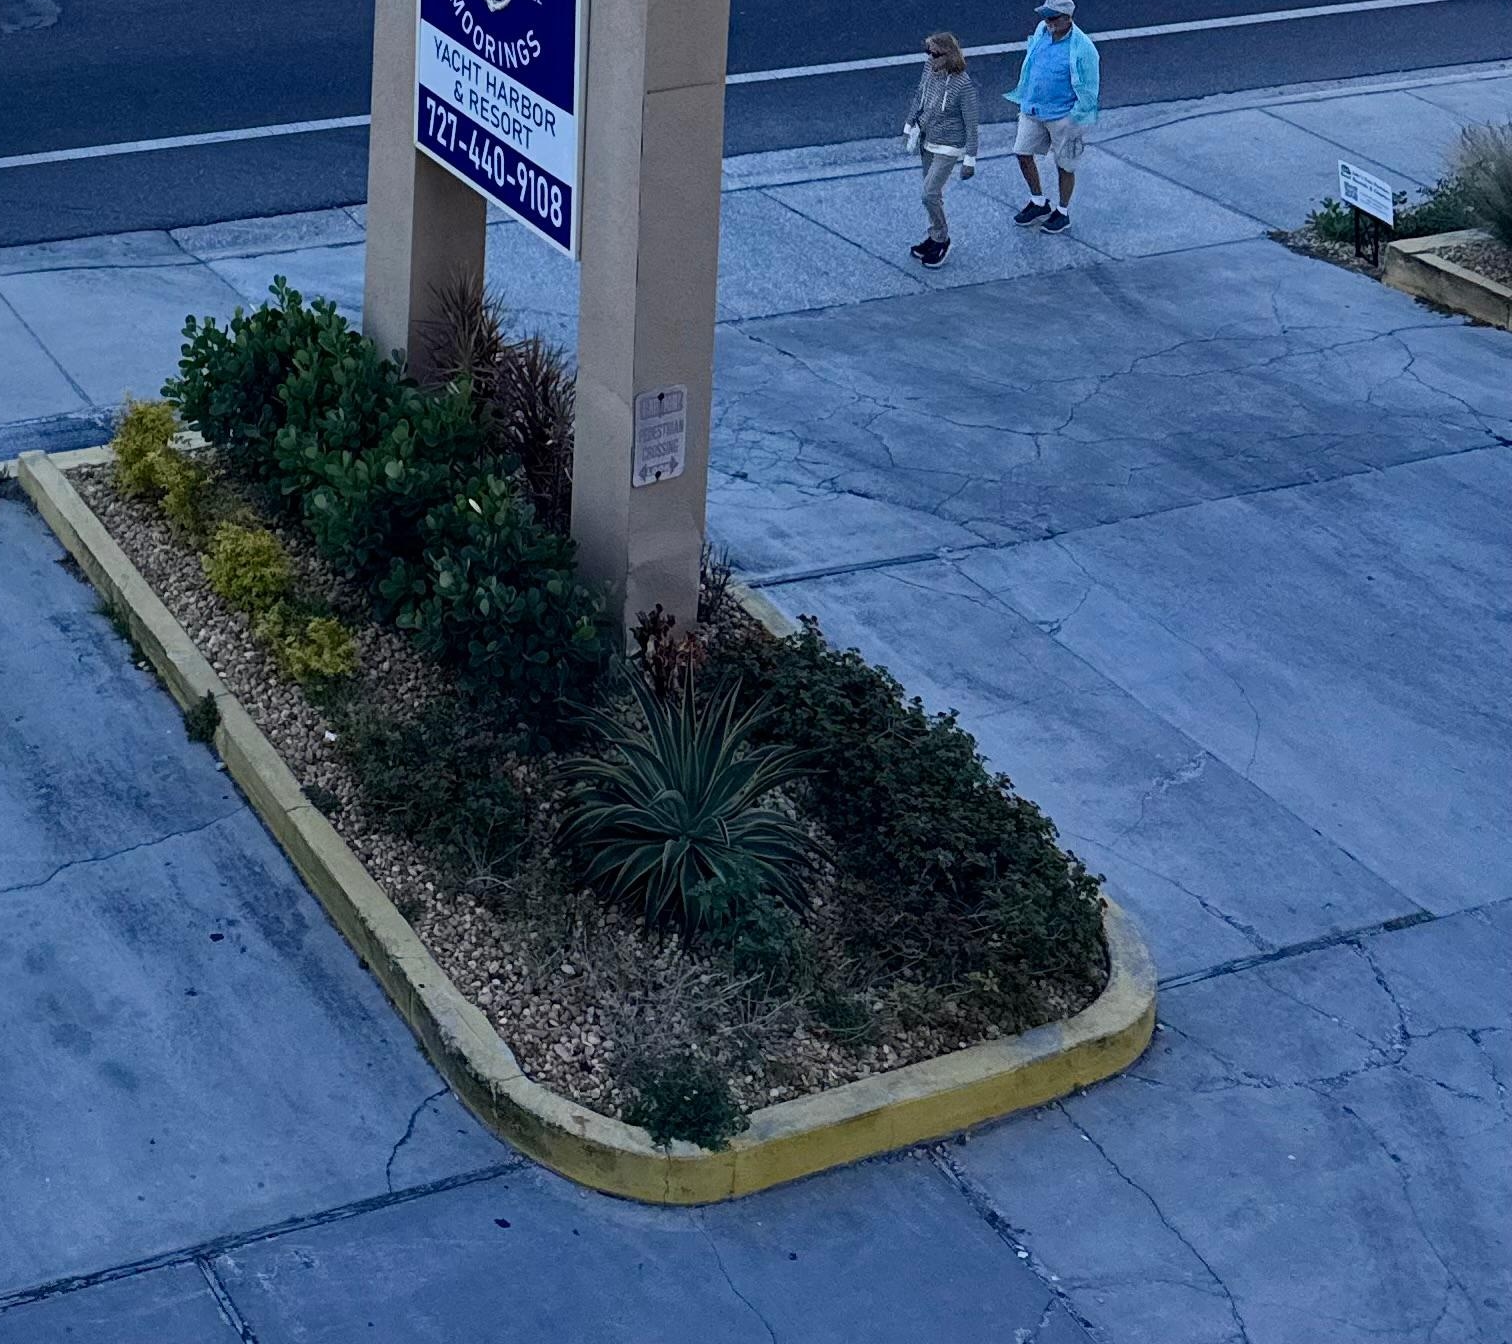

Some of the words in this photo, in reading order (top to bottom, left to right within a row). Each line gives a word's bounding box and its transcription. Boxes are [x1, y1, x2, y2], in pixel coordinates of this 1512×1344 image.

[433, 35, 482, 83] YACHT
[487, 73, 556, 137] HARBOR
[453, 80, 465, 106] &
[469, 92, 533, 150] RESORT
[425, 96, 563, 228] 727-440-9108
